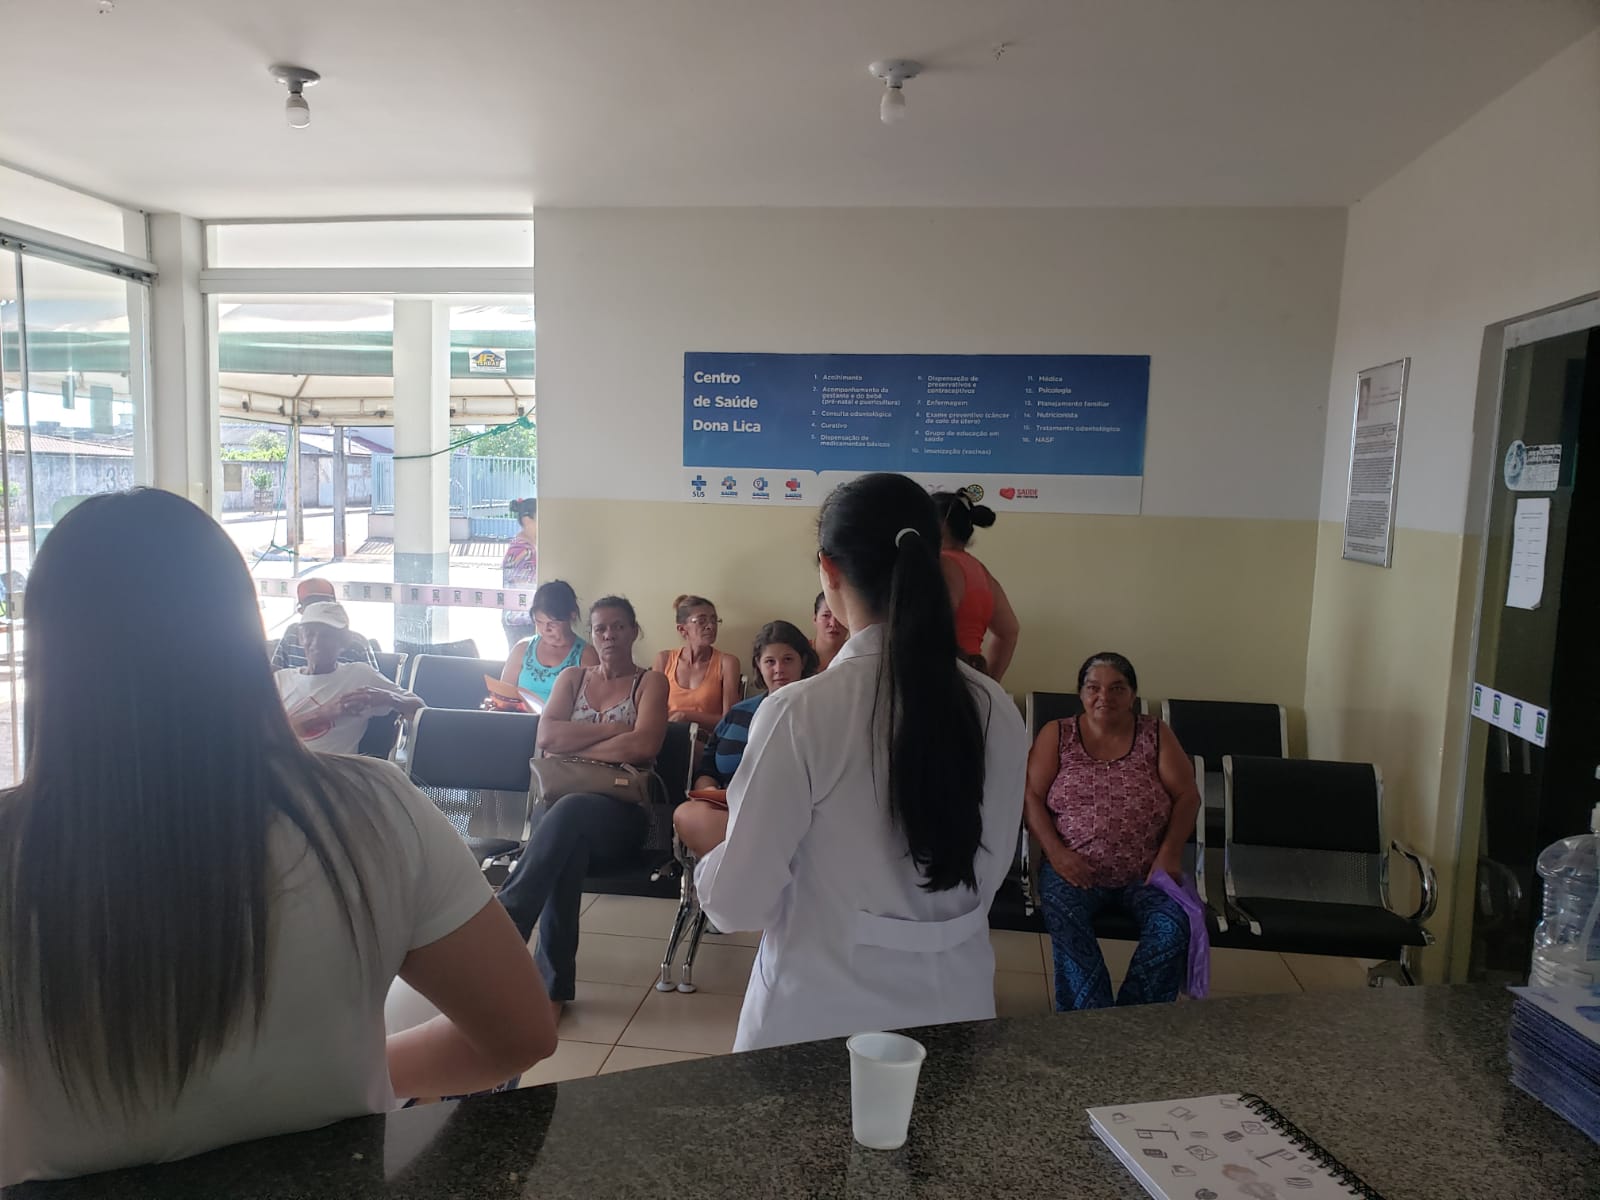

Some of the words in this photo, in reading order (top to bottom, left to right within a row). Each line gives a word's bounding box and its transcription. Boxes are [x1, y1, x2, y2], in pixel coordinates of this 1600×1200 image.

[693, 371, 741, 384] Centro
[822, 386, 880, 394] Acompanhamento
[1038, 387, 1072, 395] Psicologia
[693, 395, 711, 407] de
[715, 395, 758, 409] Saúde
[926, 399, 968, 407] Enfermagem
[1037, 400, 1083, 408] Planejamento
[693, 419, 729, 432] Dona
[733, 420, 761, 433] Lica
[1036, 424, 1074, 432] Tratamento
[820, 434, 860, 442] Dispensação
[956, 430, 988, 438] educação
[923, 447, 961, 455] Imunização
